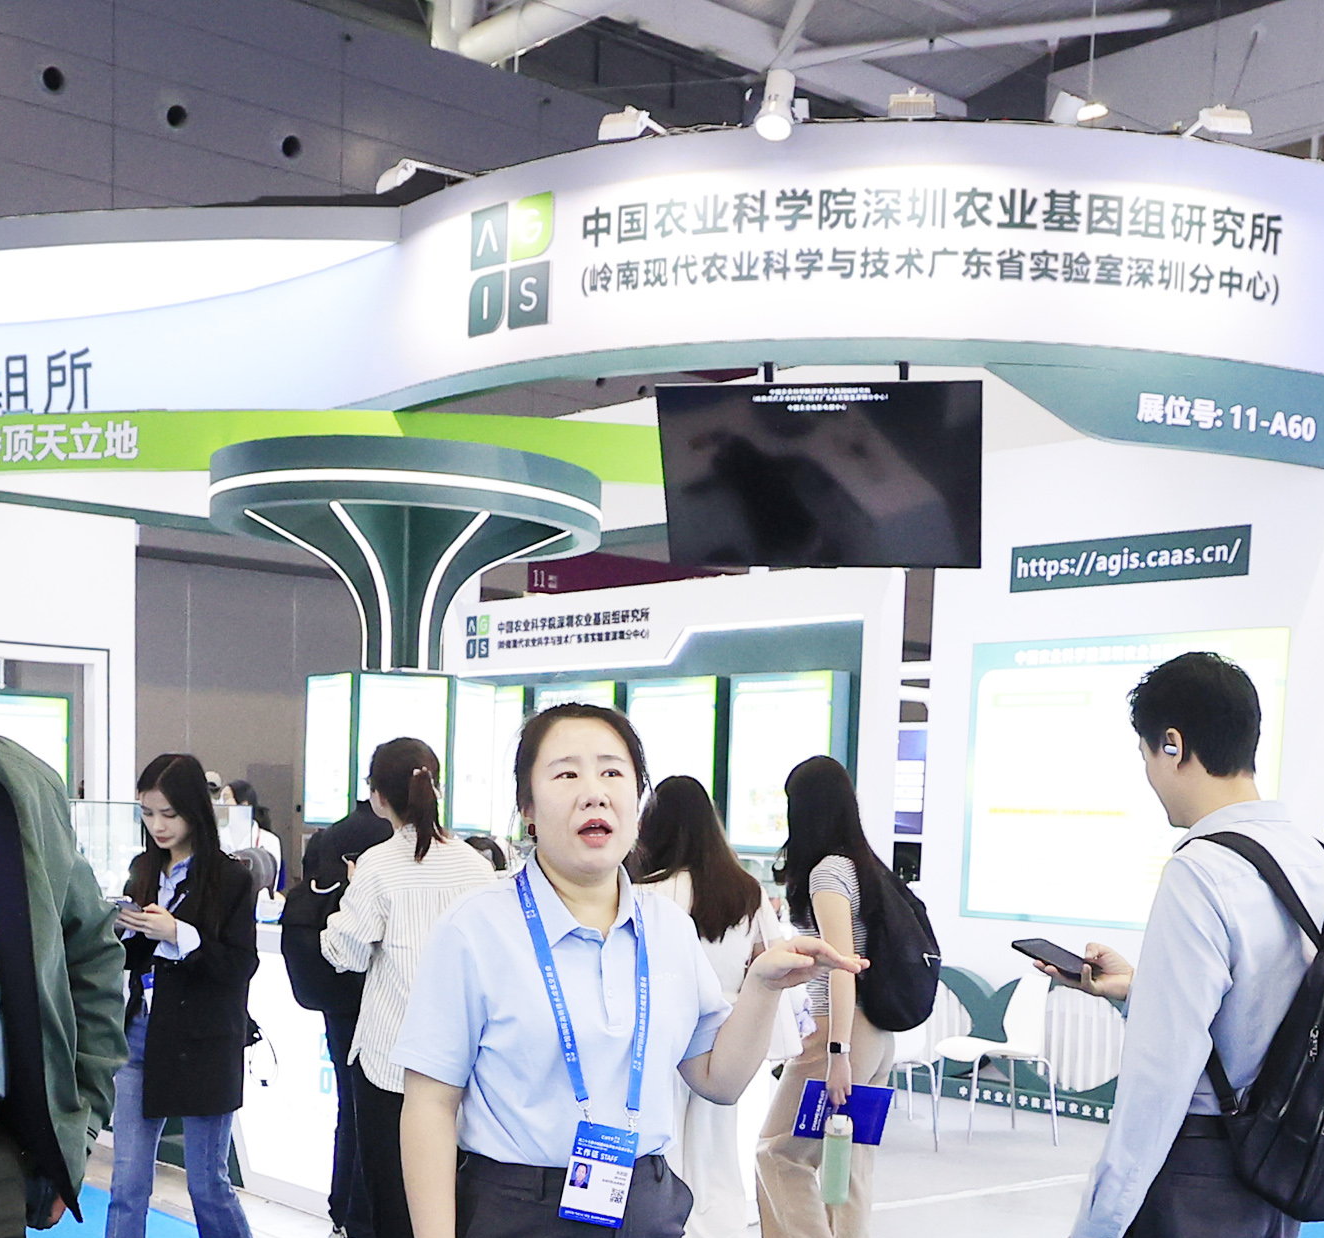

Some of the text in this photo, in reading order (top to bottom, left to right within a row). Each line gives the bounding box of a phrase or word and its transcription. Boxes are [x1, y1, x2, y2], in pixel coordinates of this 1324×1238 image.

[582, 187, 1282, 255] 中国农业科学院深圳农业基因组研究所
[581, 246, 1279, 305] (岭南现代农业科学与技术广东省实验室深圳分中心)
[1136, 392, 1317, 442] 展位号: 11-A60
[533, 569, 545, 588] 11
[1016, 538, 1242, 582] https://agis.caas.cn/
[575, 1146, 599, 1159] 工作证
[600, 1152, 619, 1163] STAFF
